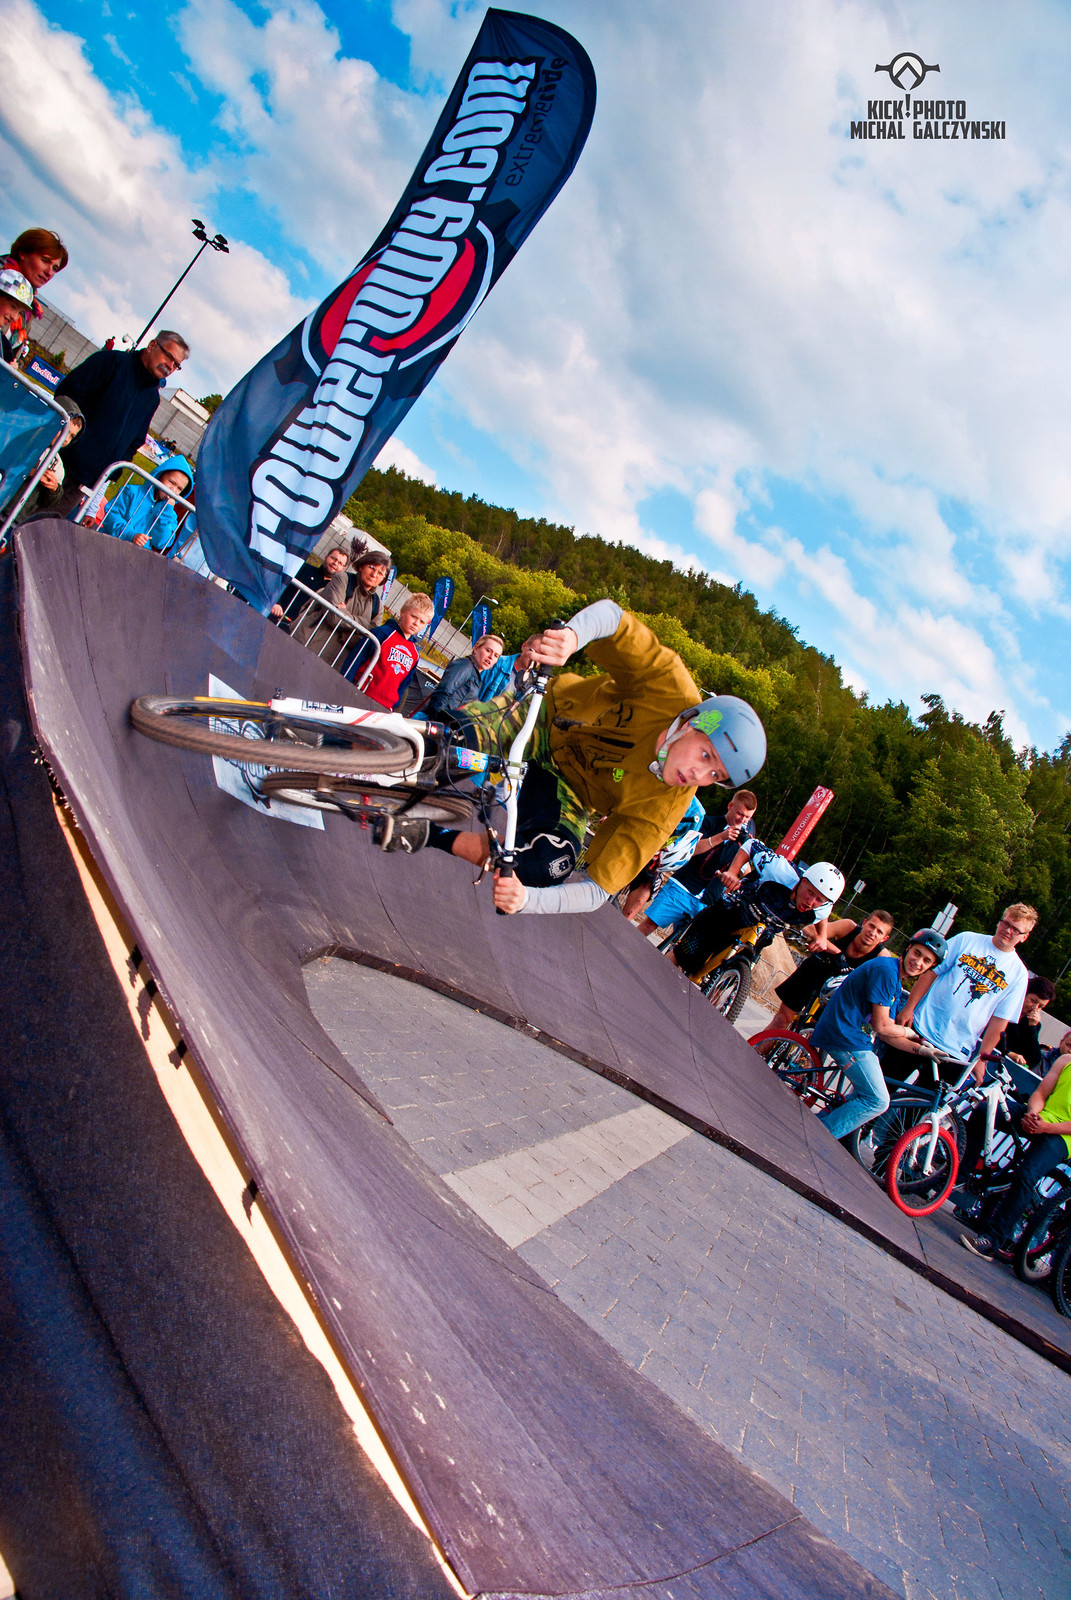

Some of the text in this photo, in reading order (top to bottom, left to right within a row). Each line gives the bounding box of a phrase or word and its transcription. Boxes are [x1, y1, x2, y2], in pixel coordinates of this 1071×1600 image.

[249, 61, 537, 578] rowerowy.com
[387, 646, 413, 672] KINGS
[790, 812, 813, 842] VICTORIA
